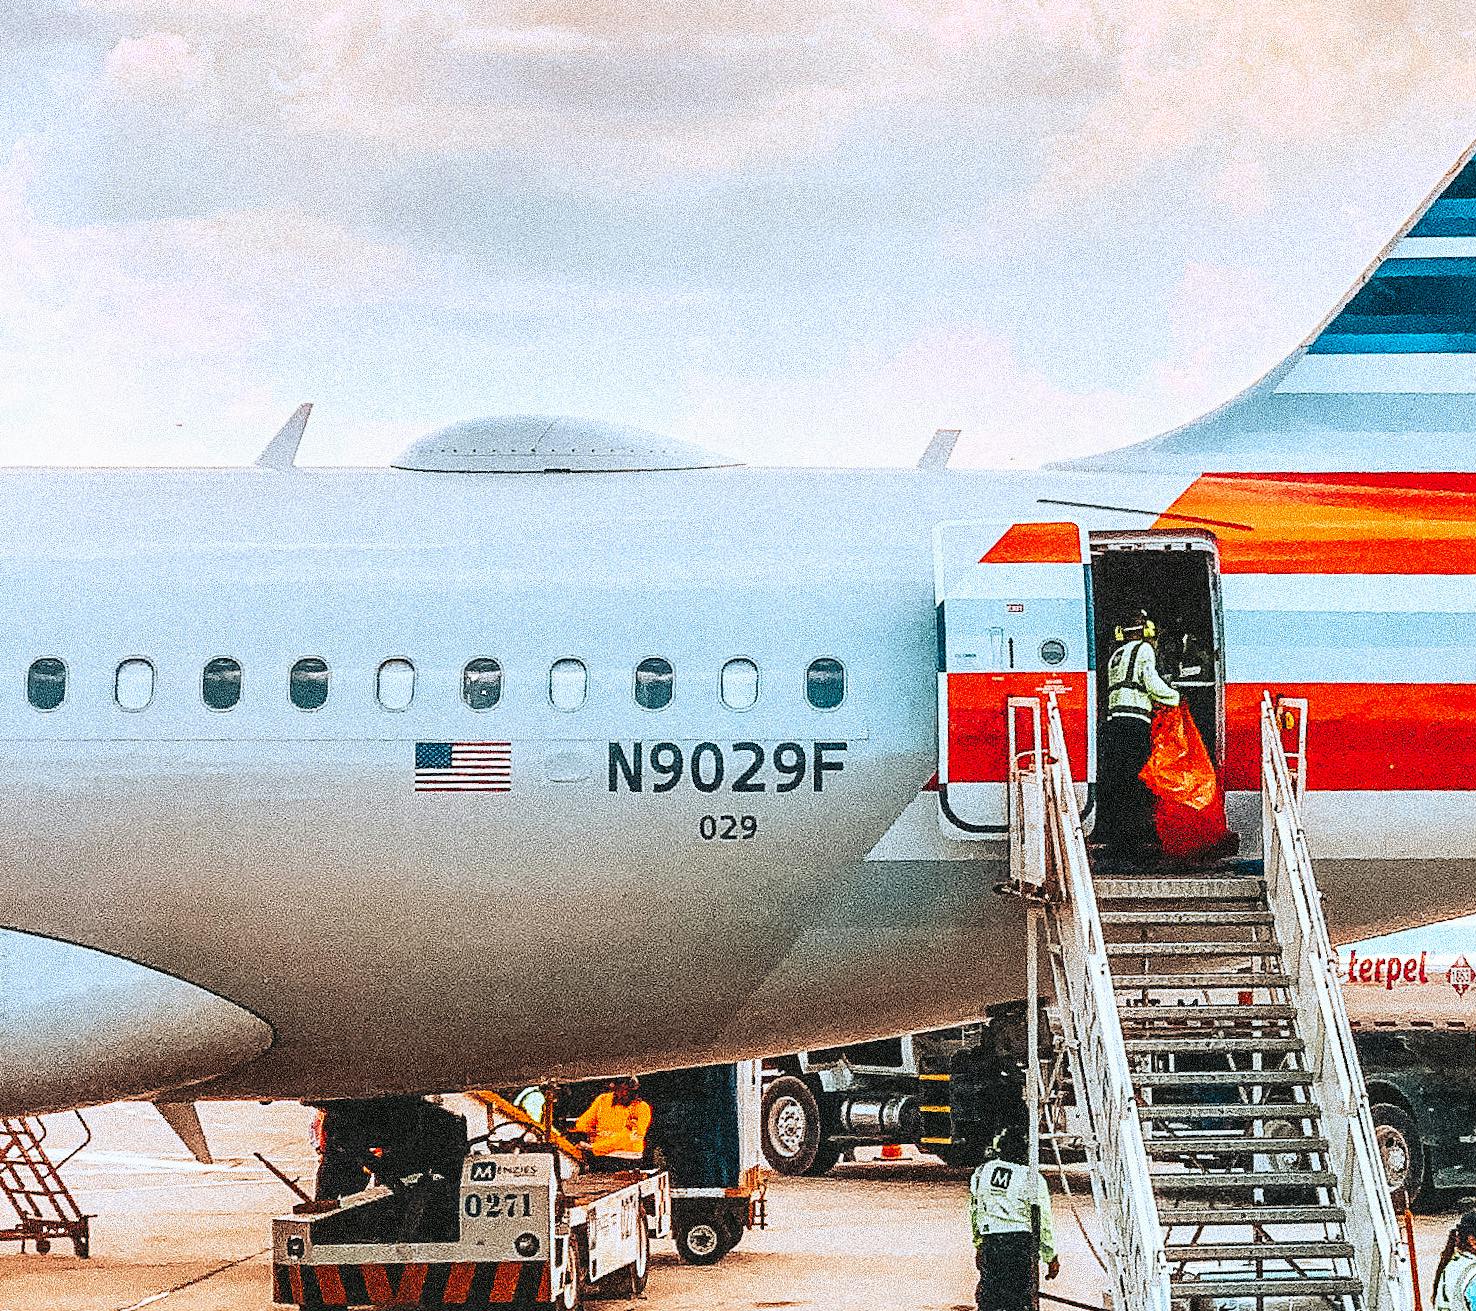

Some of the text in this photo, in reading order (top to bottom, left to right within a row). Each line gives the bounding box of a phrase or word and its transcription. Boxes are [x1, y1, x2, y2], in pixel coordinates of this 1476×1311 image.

[608, 741, 848, 793] N9029F
[700, 814, 758, 840] 029
[1348, 949, 1429, 990] terpel
[991, 1168, 1011, 1188] M
[465, 1193, 532, 1218] 0271
